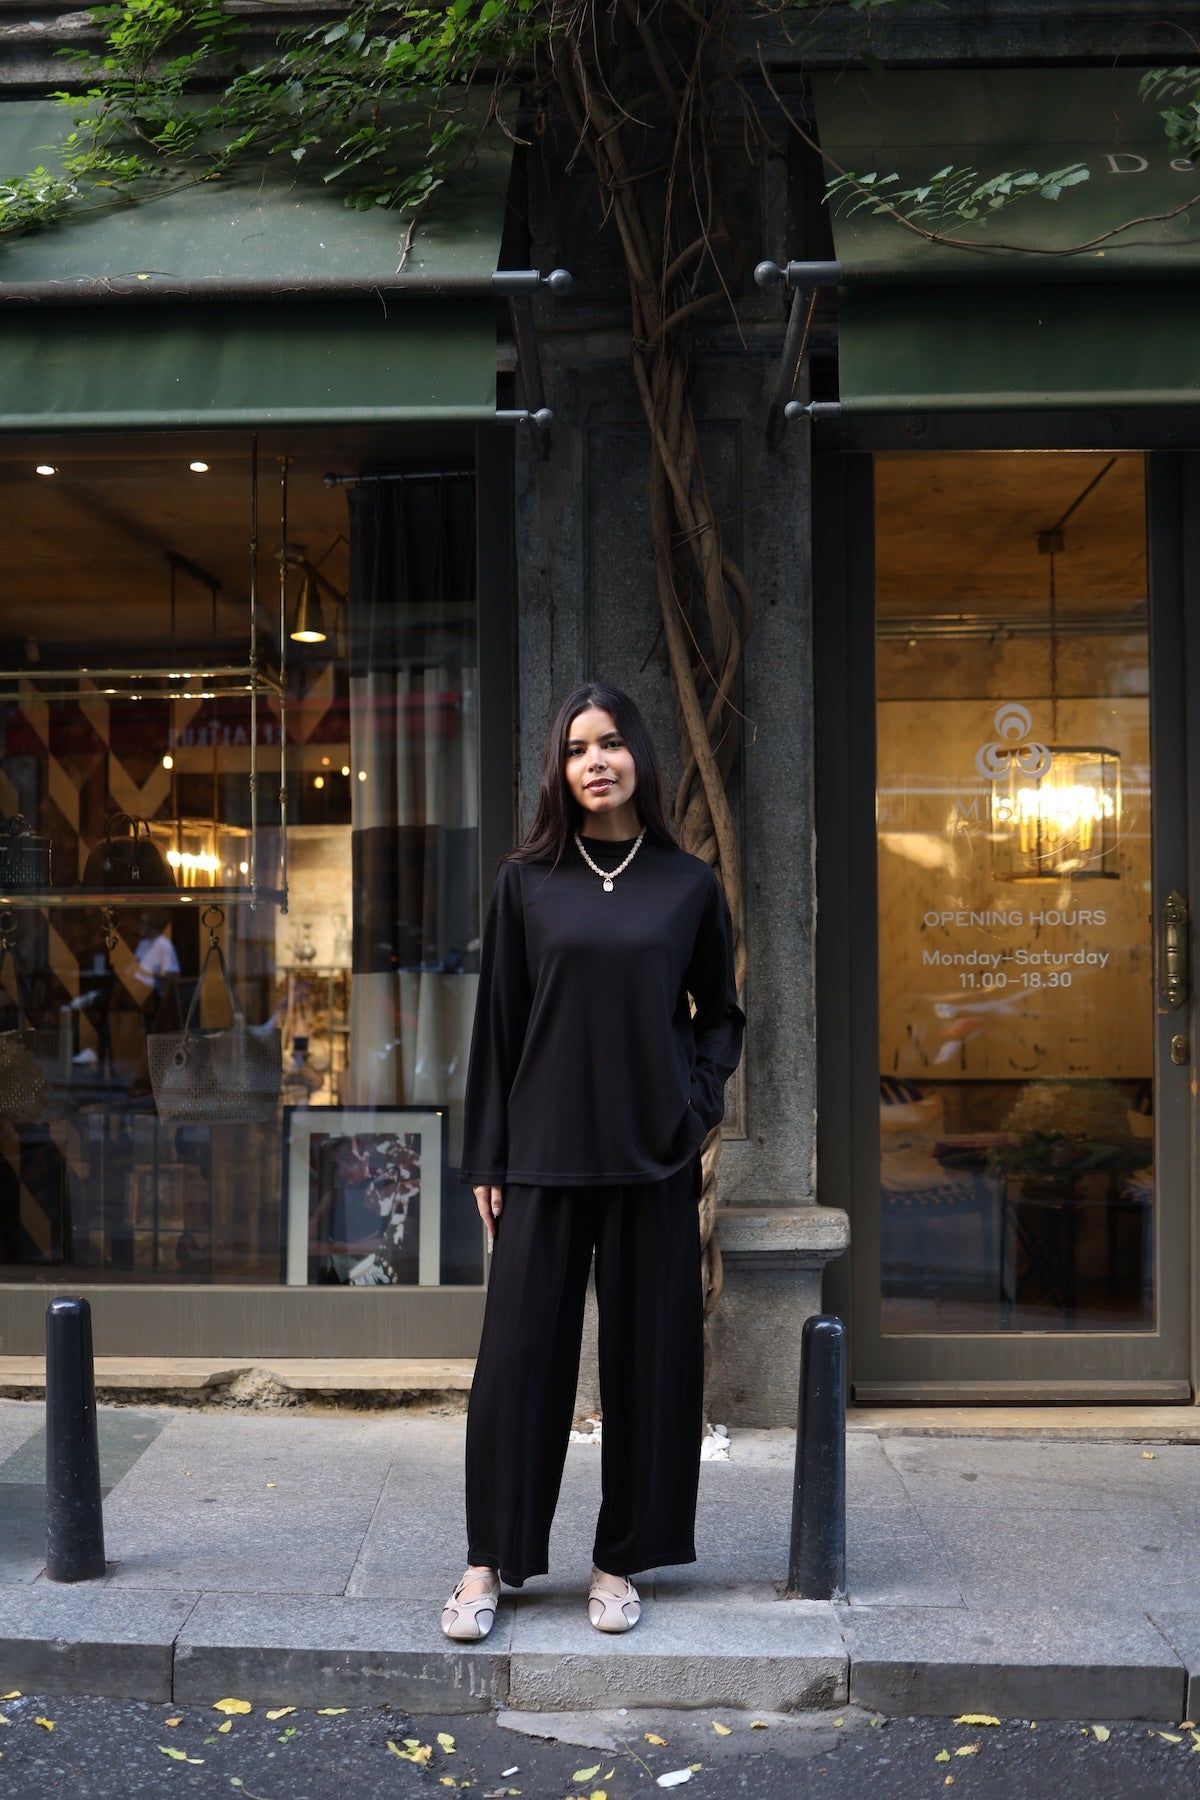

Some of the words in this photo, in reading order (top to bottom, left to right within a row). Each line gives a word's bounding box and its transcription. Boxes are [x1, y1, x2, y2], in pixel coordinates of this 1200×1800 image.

[924, 911, 1023, 927] OPENING
[1030, 910, 1107, 926] HOURS
[959, 971, 1073, 988] 11.00–18.30
